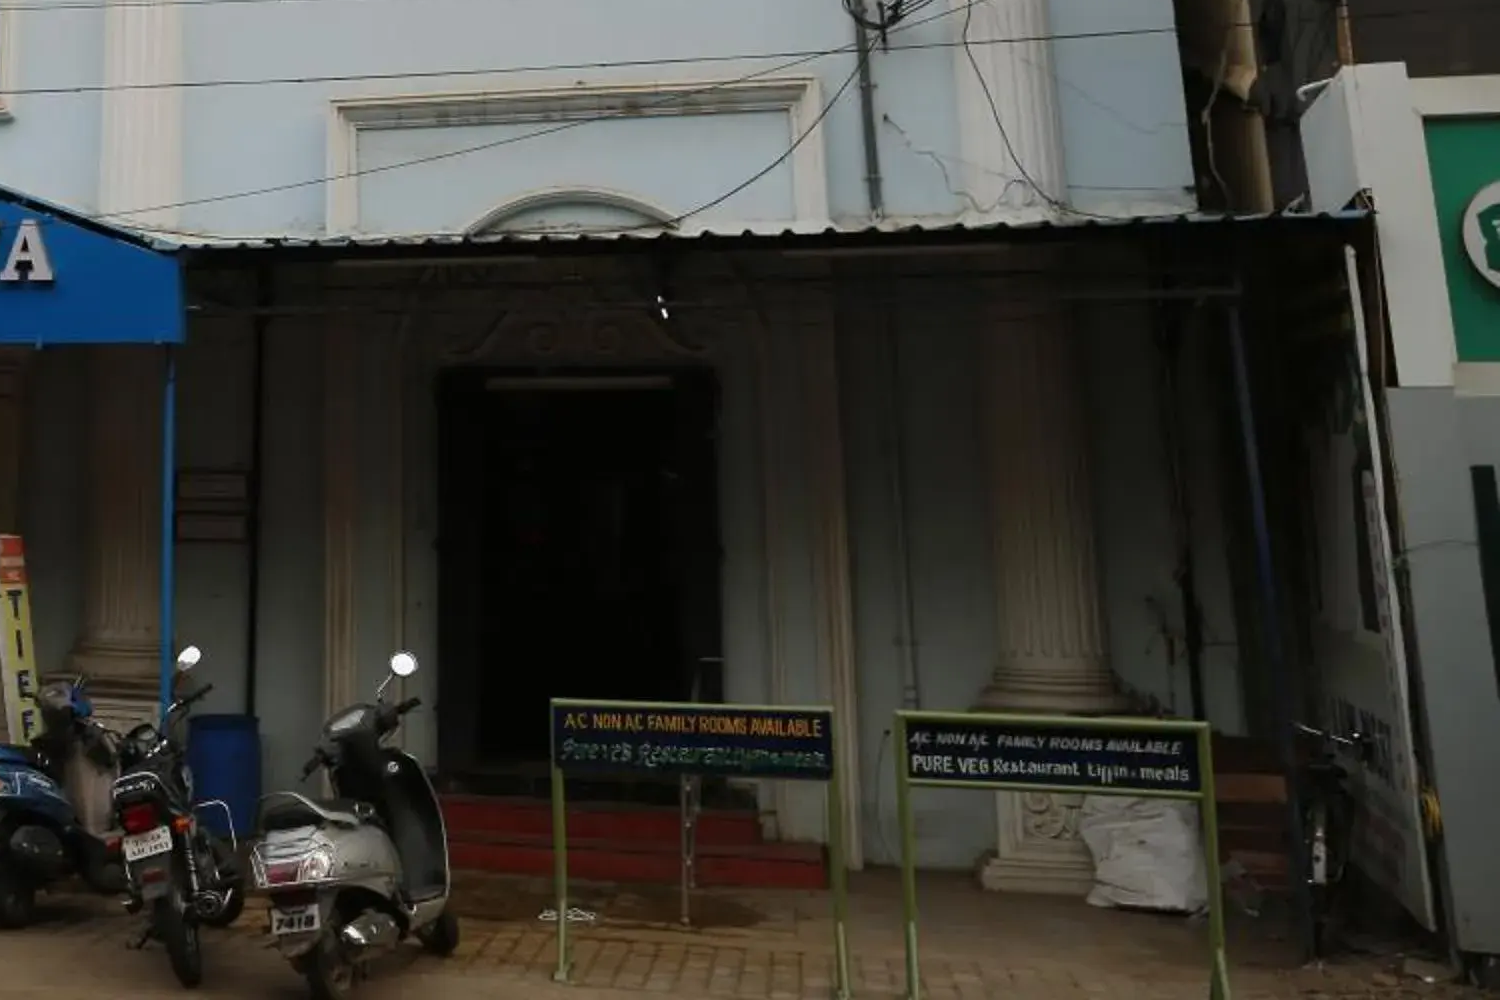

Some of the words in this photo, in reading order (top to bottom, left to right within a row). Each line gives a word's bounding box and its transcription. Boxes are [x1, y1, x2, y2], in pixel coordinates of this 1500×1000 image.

[593, 713, 620, 730] NON
[647, 714, 697, 732] FAMILY
[699, 715, 747, 735] ROOMS
[750, 718, 823, 738] AVAILABLE
[997, 734, 1046, 748] FAMILY
[1049, 737, 1102, 751] ROOMS
[1106, 739, 1182, 755] AVAILABLE
[912, 754, 954, 773] PURE
[957, 757, 989, 774] VEG
[993, 758, 1080, 776] Restaurant
[1140, 765, 1190, 781] meals
